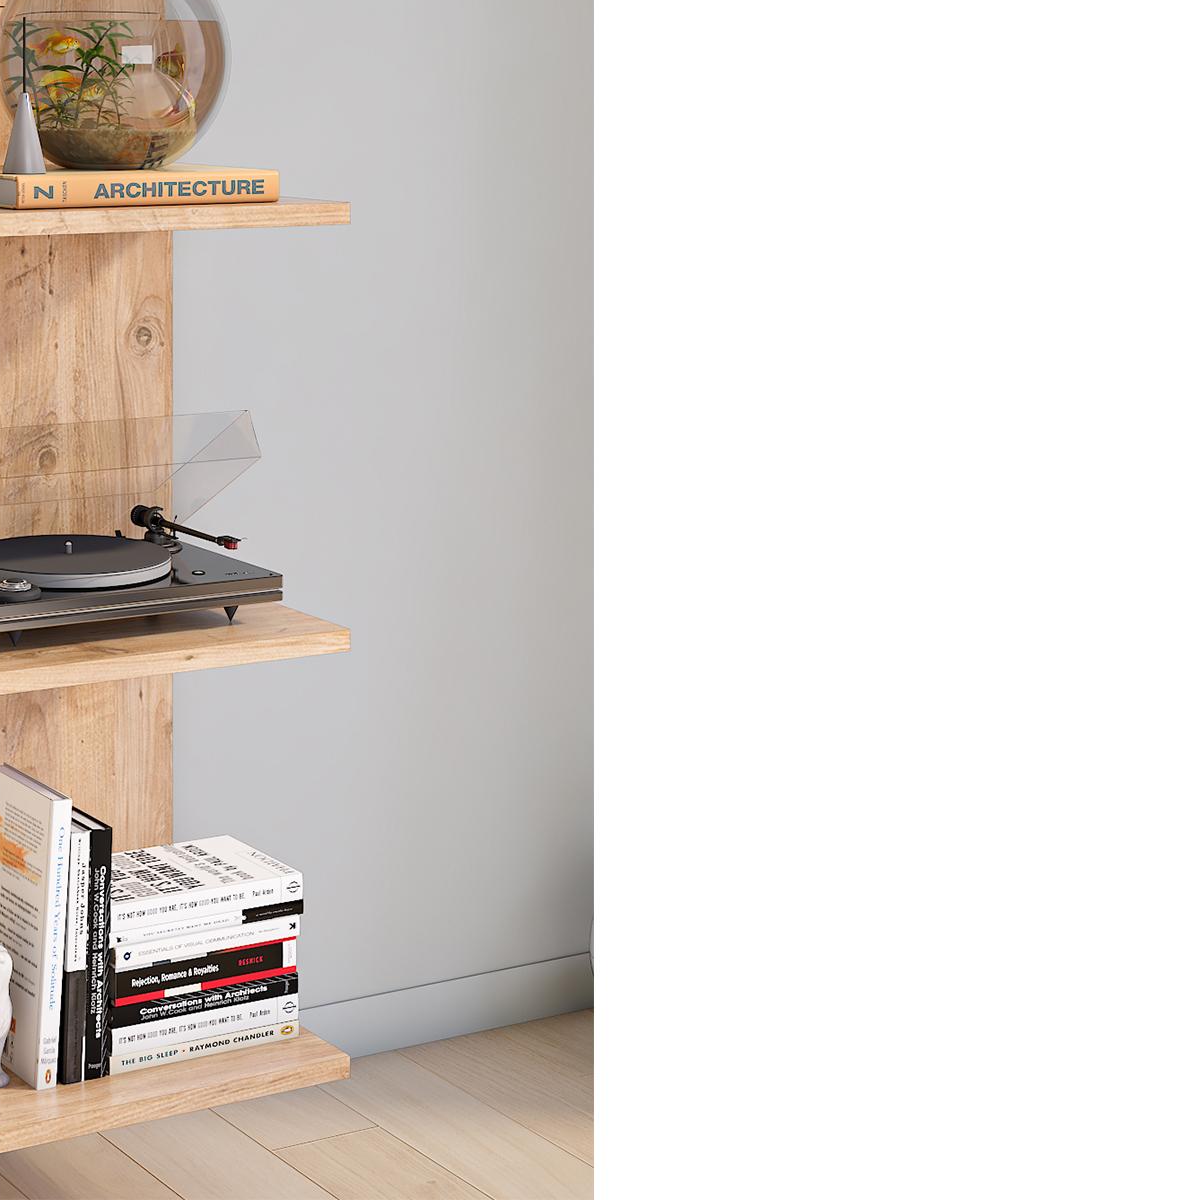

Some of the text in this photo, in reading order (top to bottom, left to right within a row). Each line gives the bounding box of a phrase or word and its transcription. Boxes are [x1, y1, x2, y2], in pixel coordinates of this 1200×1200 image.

[94, 179, 264, 199] ARCHITECTURE
[55, 856, 63, 908] Hundred
[98, 866, 106, 949] Conversations
[52, 912, 60, 941] Years
[138, 945, 173, 956] ESSENTIALS
[205, 931, 255, 944] COMMUNICATION
[132, 956, 263, 987] Rejection, Romance & Royalties RESNICK
[49, 964, 57, 1010] Solitude
[140, 998, 202, 1015] Conversations
[204, 994, 223, 1003] with
[225, 985, 268, 998] Architects
[95, 980, 103, 1039] Architects
[141, 1011, 158, 1020] John
[188, 1003, 202, 1011] and
[204, 998, 232, 1008] Heinrich
[219, 1016, 229, 1024] WANT
[121, 1058, 135, 1066] THE
[156, 1050, 178, 1059] SLEEP
[189, 1039, 230, 1052] RAYMOND
[233, 1030, 274, 1043] CHANDLER
